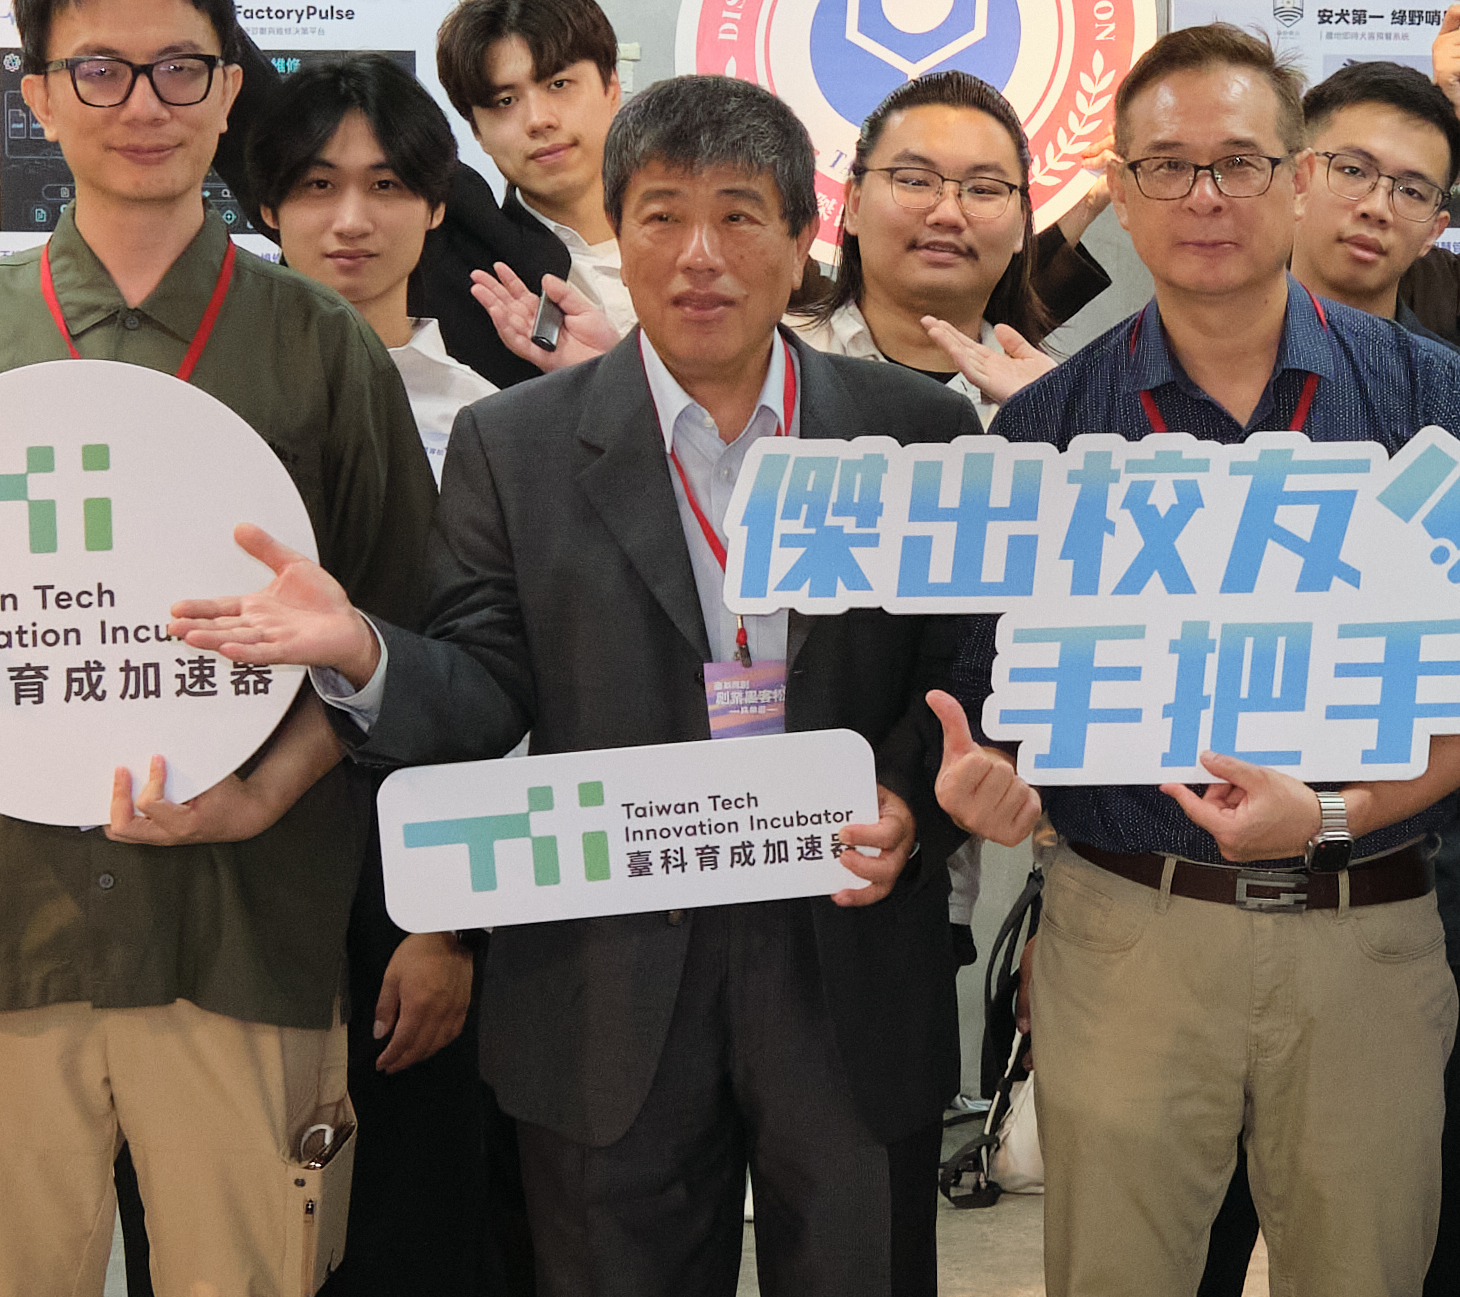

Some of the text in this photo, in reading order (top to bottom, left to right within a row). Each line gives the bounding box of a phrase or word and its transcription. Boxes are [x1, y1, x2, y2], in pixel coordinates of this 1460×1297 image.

[235, 5, 355, 23] FactoryPulse
[1317, 8, 1448, 26] 安犬第一 綠野哨
[740, 448, 1373, 601] 傑出校友
[33, 583, 116, 611] Tech
[100, 619, 181, 646] Incu
[622, 792, 759, 821] Taiwan Tech
[624, 806, 855, 843] Innovation Incubator
